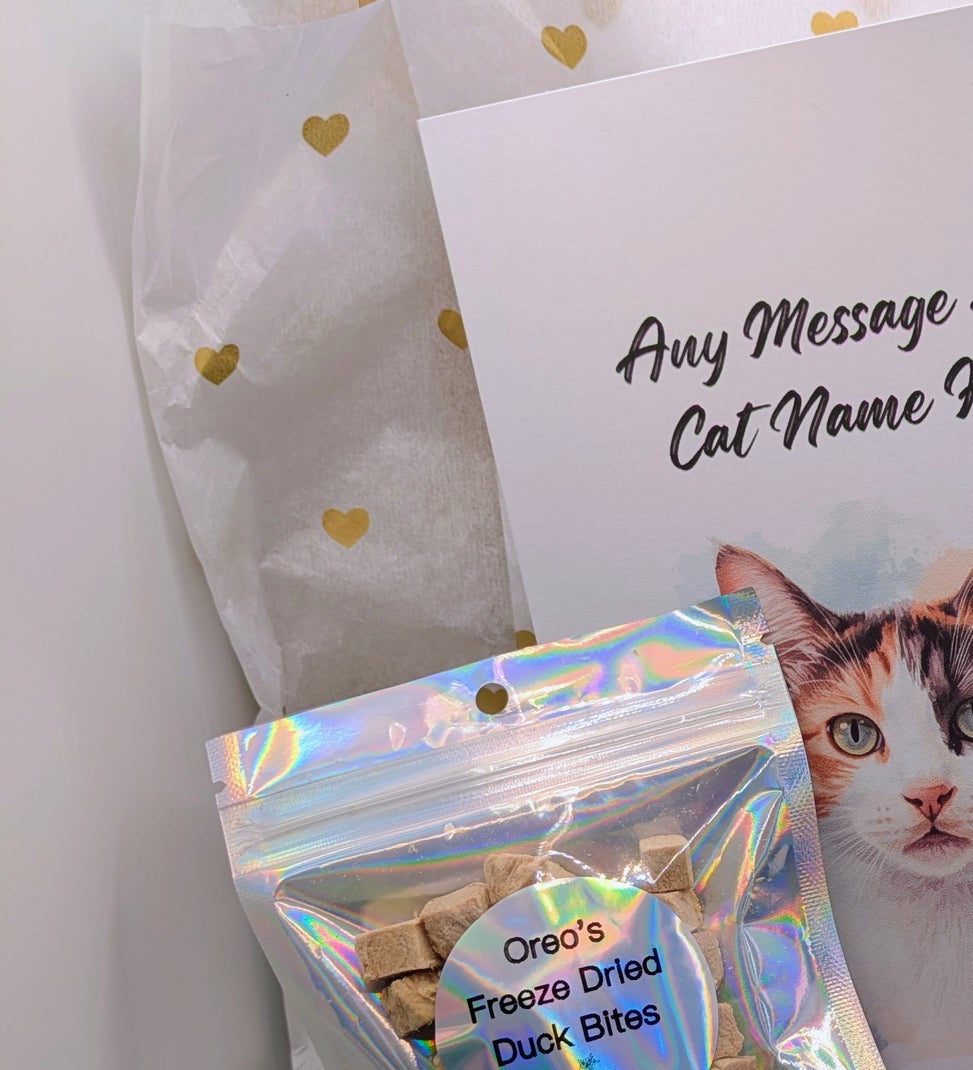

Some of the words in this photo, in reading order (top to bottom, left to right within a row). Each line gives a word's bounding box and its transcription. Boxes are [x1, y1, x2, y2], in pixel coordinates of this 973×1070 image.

[616, 316, 728, 387] Any
[743, 290, 958, 360] Message
[669, 402, 772, 471] Cat
[769, 385, 935, 450] Name
[503, 919, 606, 964] Oreo's
[466, 979, 571, 1025] Freeze
[578, 947, 663, 994] Dried
[492, 1023, 575, 1067] Duck
[579, 1003, 661, 1043] Bites
